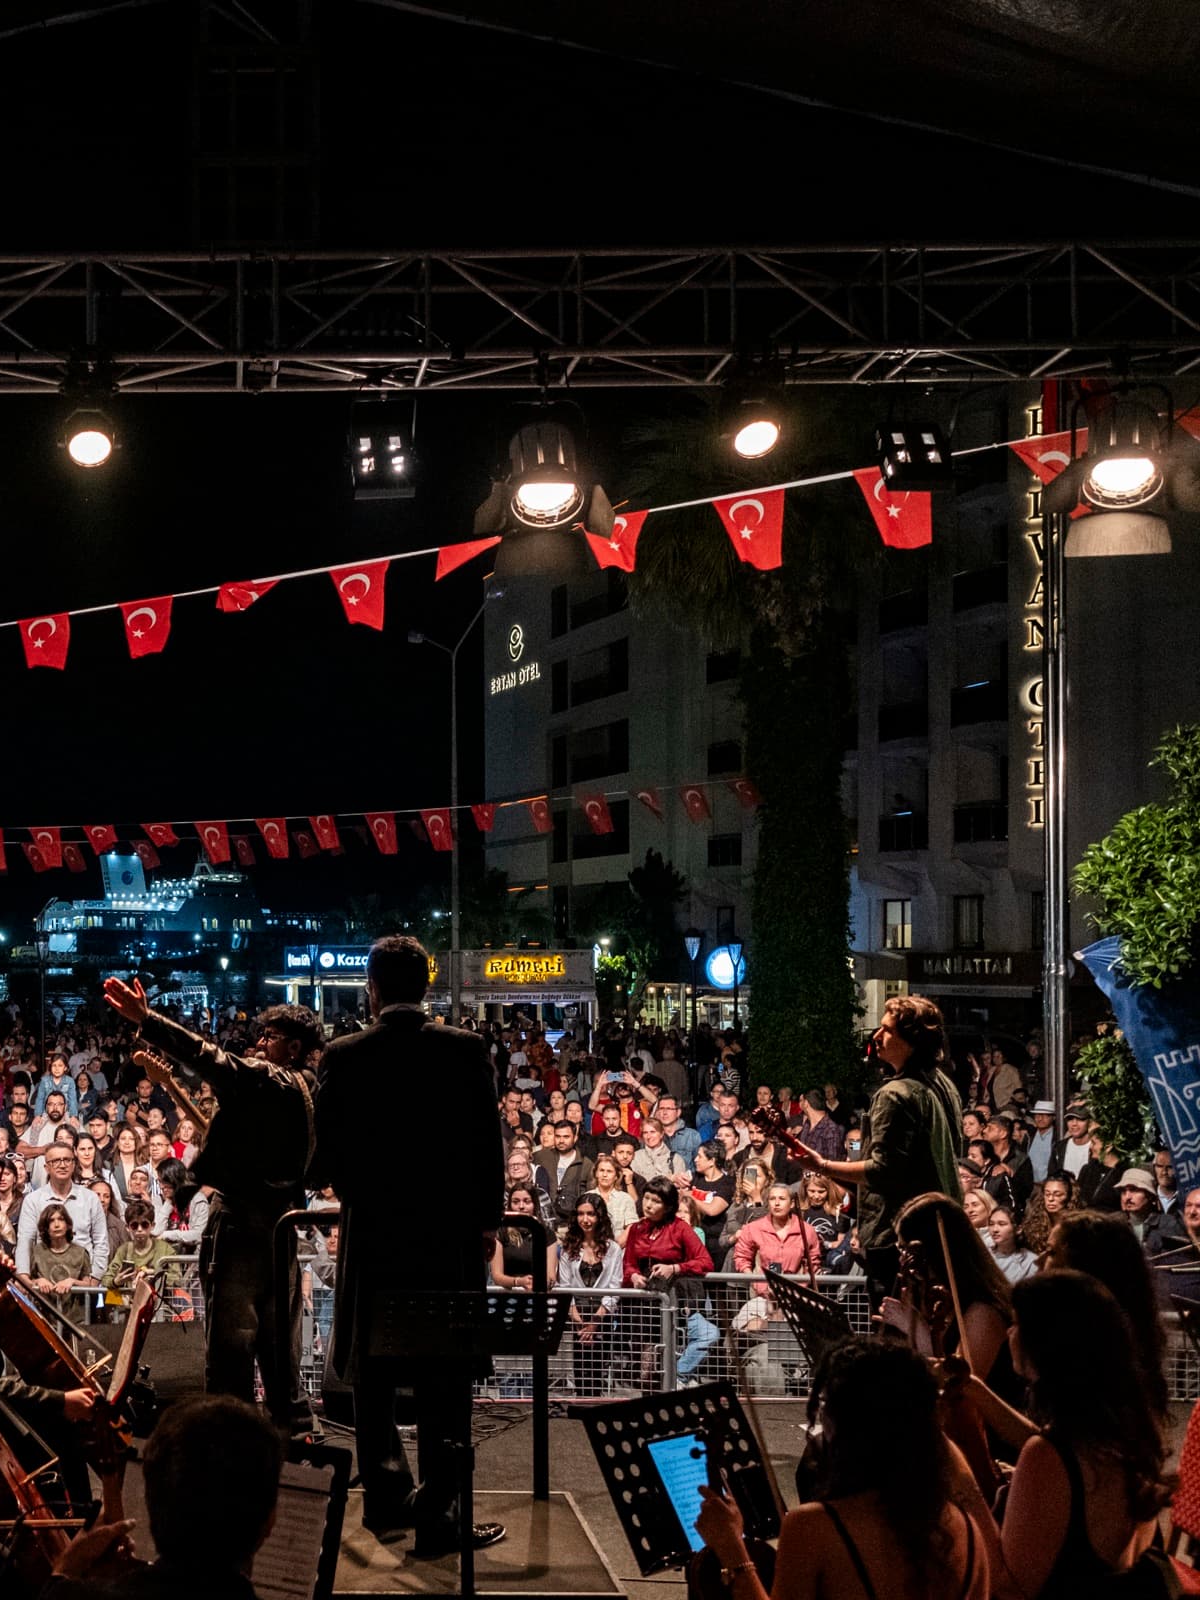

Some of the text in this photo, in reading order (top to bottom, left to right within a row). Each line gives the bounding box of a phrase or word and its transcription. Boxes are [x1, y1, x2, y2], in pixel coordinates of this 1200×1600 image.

[491, 662, 541, 695] ERTAN OTEL
[923, 957, 1012, 976] MANHATTAN
